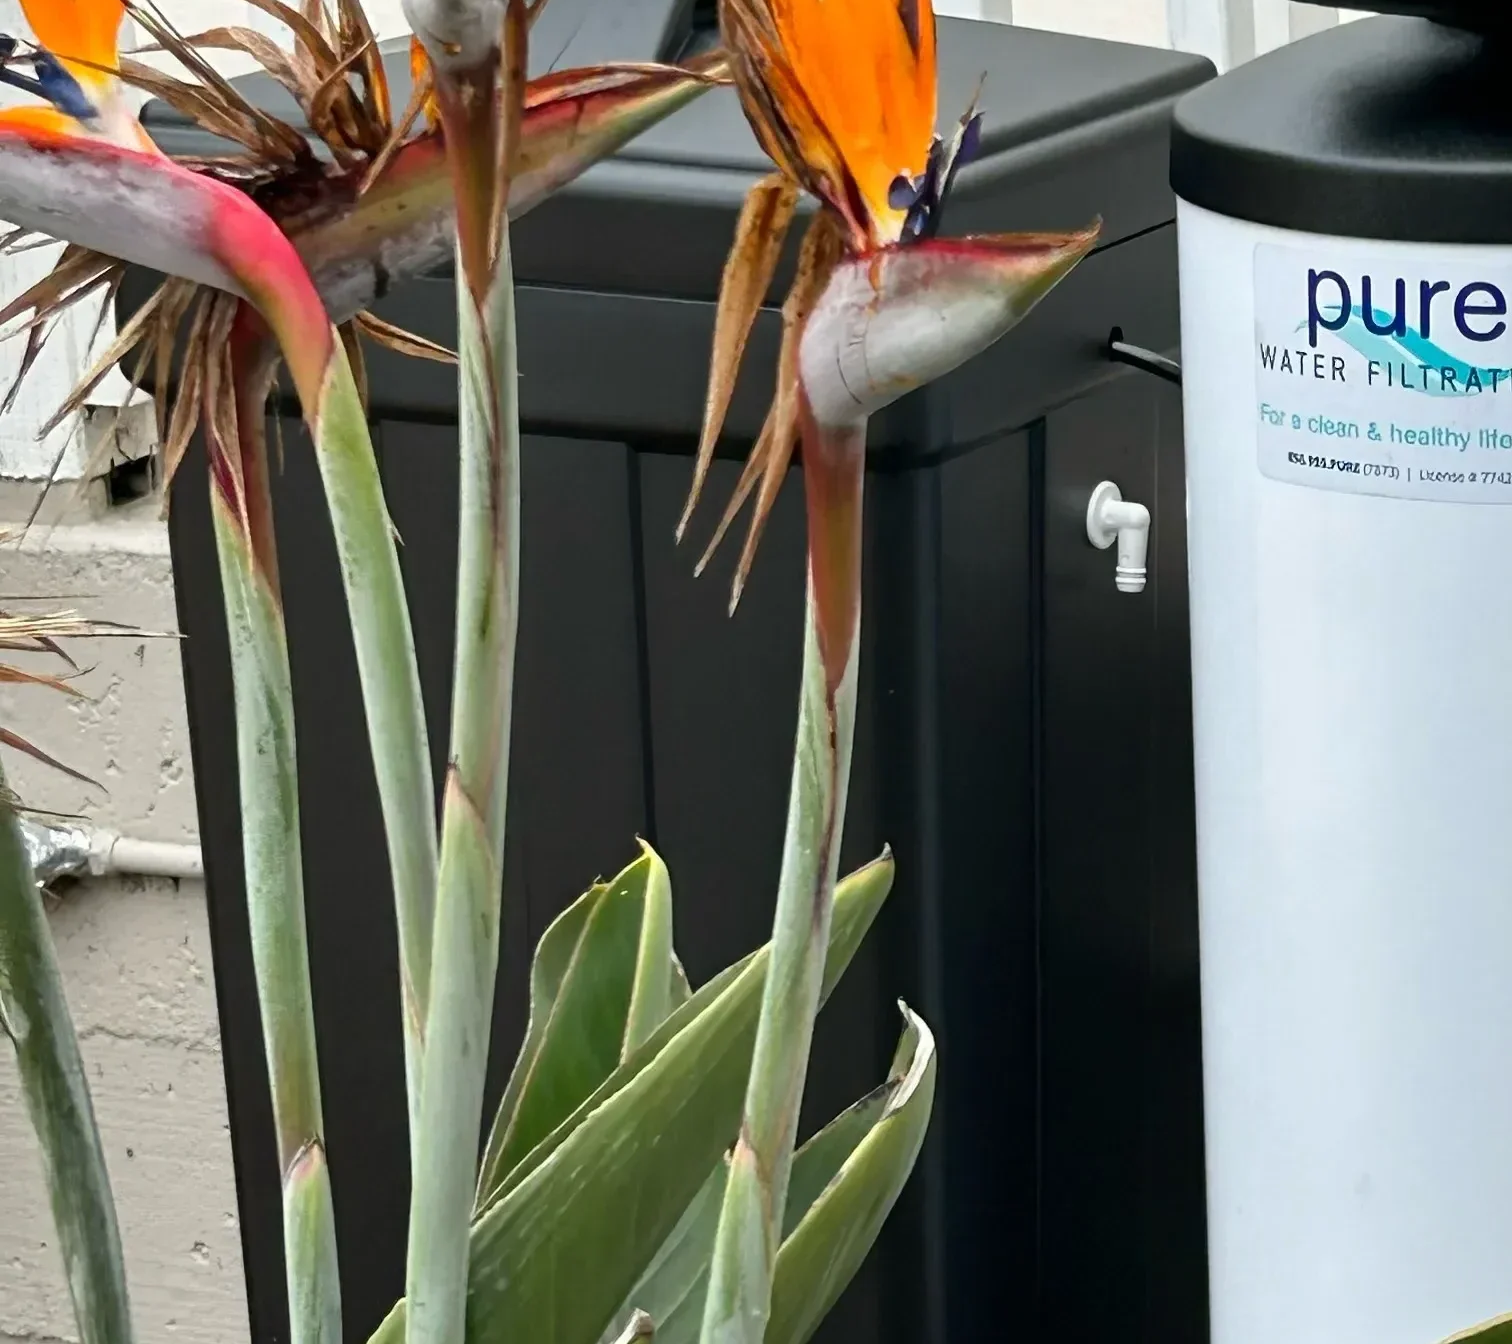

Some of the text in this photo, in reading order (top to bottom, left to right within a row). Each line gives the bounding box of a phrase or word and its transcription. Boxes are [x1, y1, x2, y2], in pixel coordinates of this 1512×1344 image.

[1307, 268, 1507, 347] pure
[1259, 343, 1346, 382] WATER
[1260, 403, 1286, 426] For
[1291, 414, 1302, 430] a
[1307, 414, 1360, 439] clean
[1366, 422, 1383, 442] &
[1390, 424, 1472, 453] healthy
